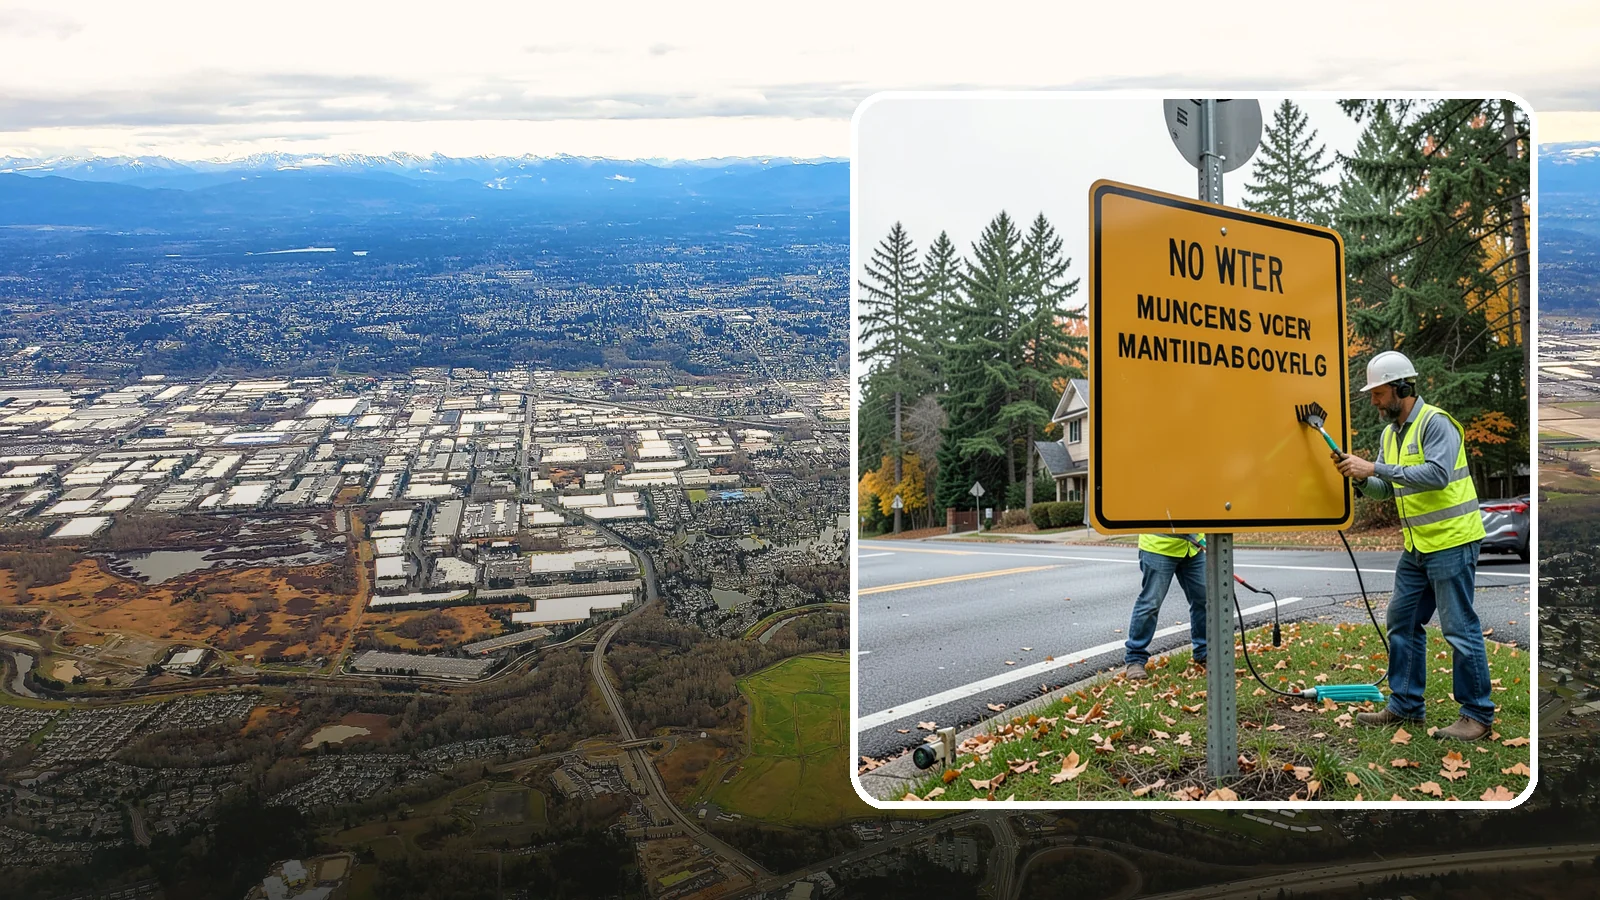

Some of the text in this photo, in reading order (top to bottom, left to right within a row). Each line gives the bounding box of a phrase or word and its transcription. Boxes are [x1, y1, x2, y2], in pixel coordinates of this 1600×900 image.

[1169, 237, 1284, 295] NO WTER
[1136, 293, 1252, 333] MUNCENS
